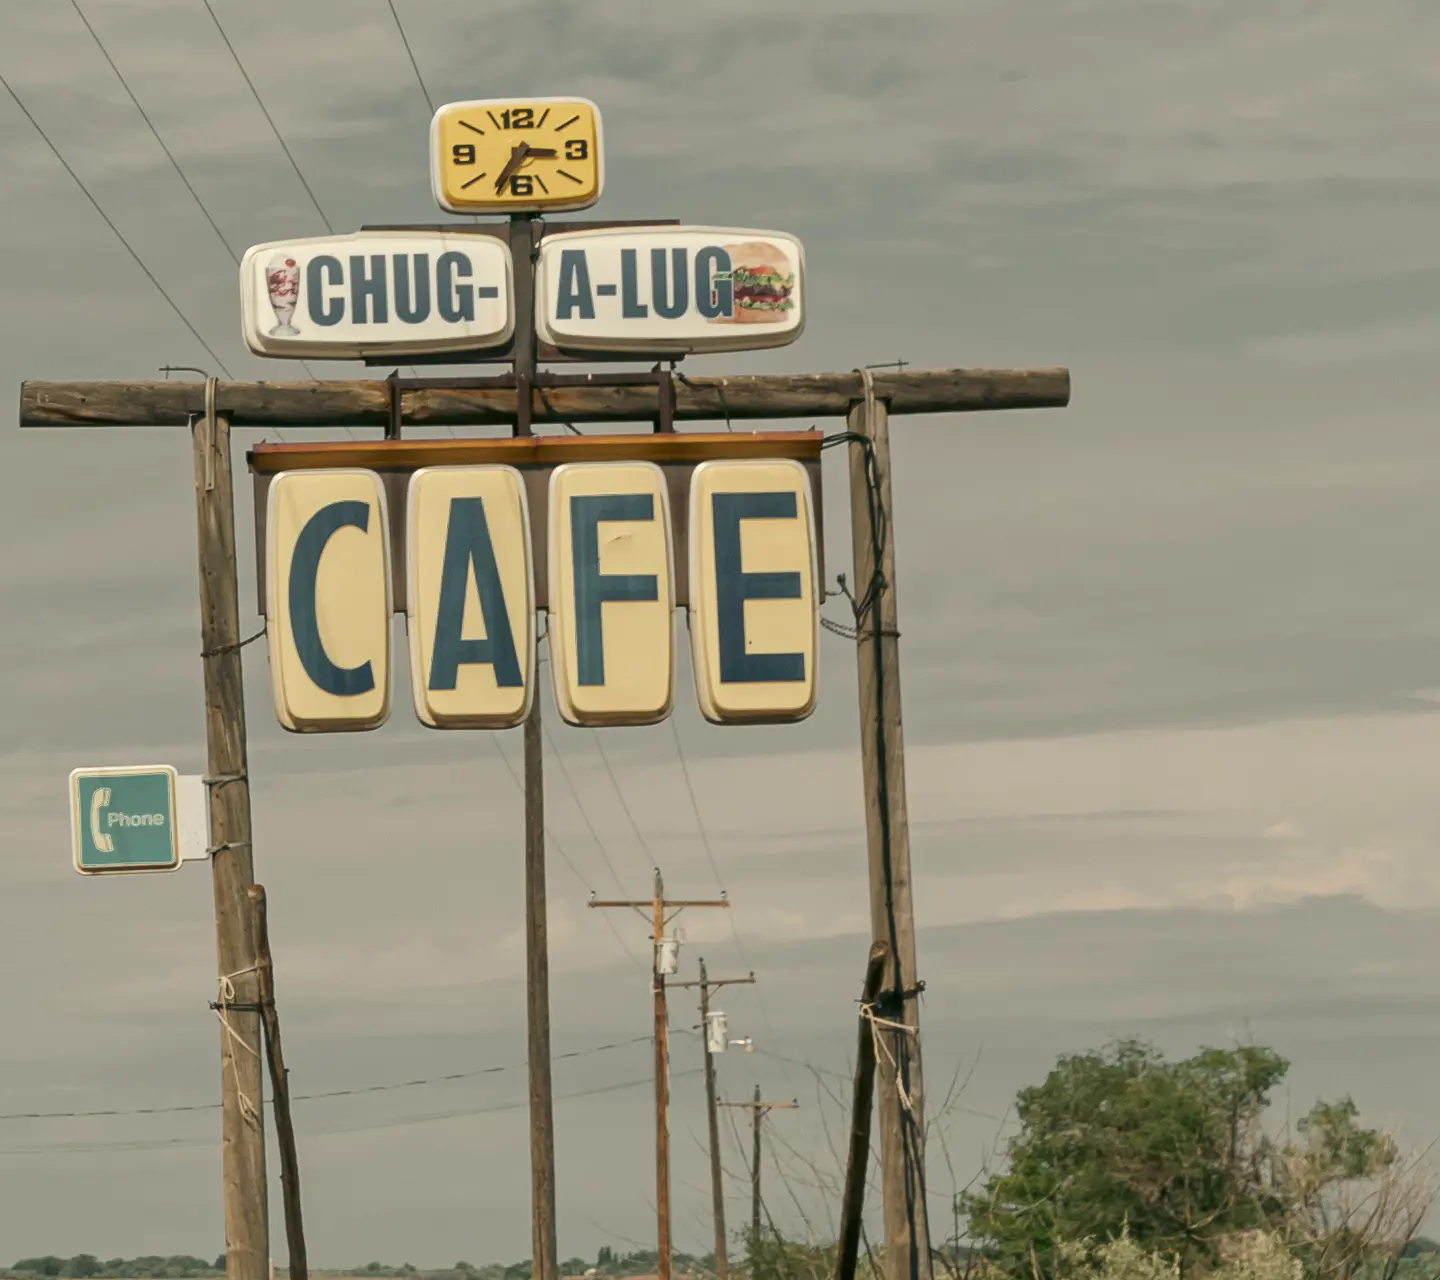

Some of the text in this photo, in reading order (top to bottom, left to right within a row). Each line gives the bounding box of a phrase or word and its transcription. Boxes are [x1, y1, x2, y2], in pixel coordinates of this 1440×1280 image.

[500, 108, 534, 130] 12
[452, 144, 476, 165] 9
[564, 139, 588, 160] 3
[510, 175, 533, 196] 6
[306, 246, 733, 326] CHUG- A-LUG
[287, 491, 806, 696] CAFE
[107, 812, 165, 827] Phone
